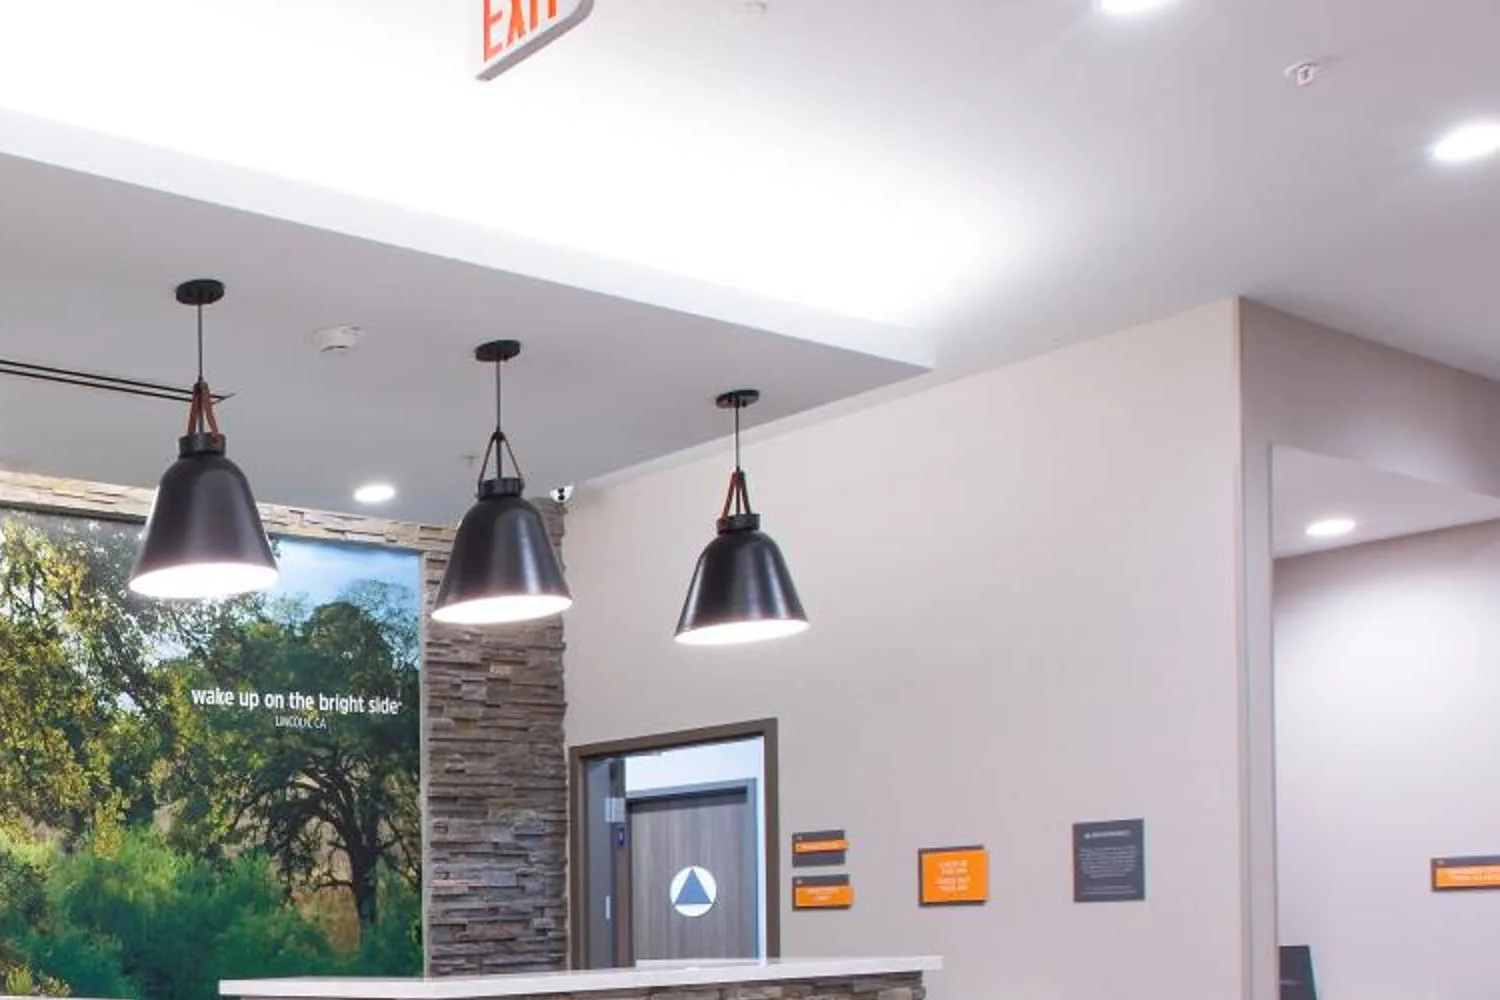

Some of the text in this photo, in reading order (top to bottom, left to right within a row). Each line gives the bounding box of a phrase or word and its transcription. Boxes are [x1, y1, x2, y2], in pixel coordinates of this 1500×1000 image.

[483, 0, 557, 62] EX
[191, 687, 235, 706] wake
[240, 691, 260, 711] up
[265, 693, 285, 709] on
[288, 691, 315, 710] the
[318, 692, 365, 715] bright
